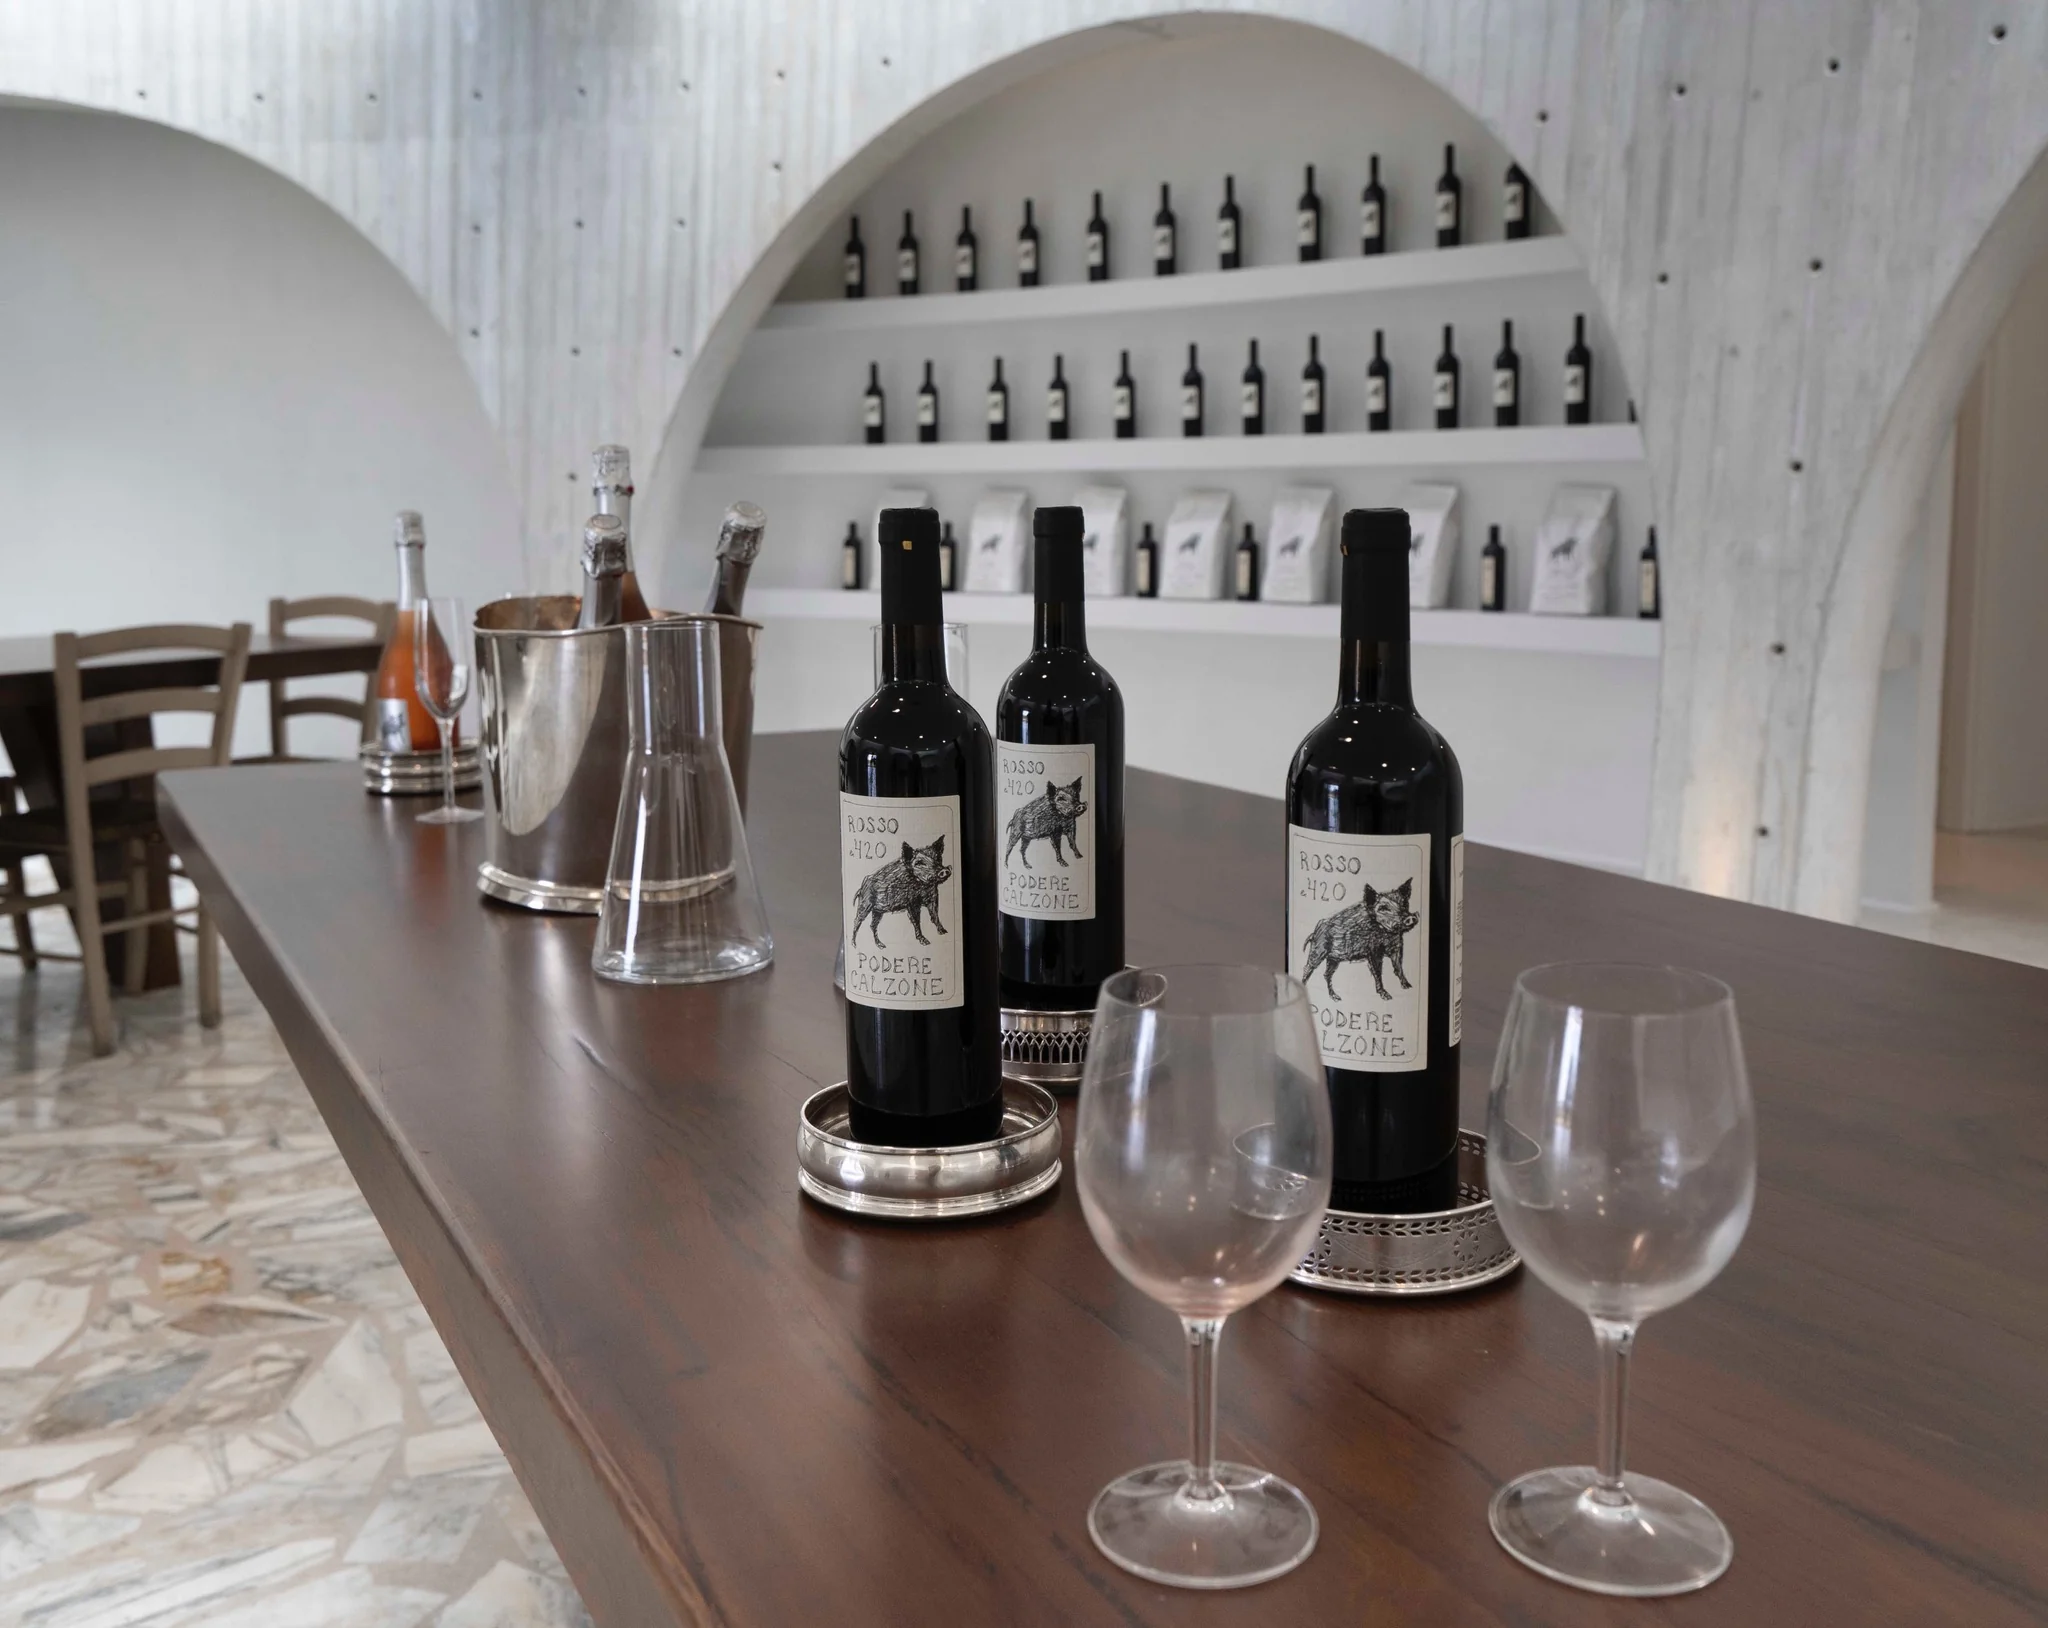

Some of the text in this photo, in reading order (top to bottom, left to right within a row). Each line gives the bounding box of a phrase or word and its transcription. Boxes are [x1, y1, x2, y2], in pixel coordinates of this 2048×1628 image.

[1003, 759, 1045, 775] ROSSO
[847, 815, 899, 834] ROSSO
[1300, 850, 1361, 875] ROSSO
[1009, 872, 1070, 892] PODERE
[1003, 887, 1079, 909] CALZONE
[857, 952, 932, 975] PODERE
[851, 970, 944, 996] CALZONE
[1322, 1029, 1405, 1057] LZONE
